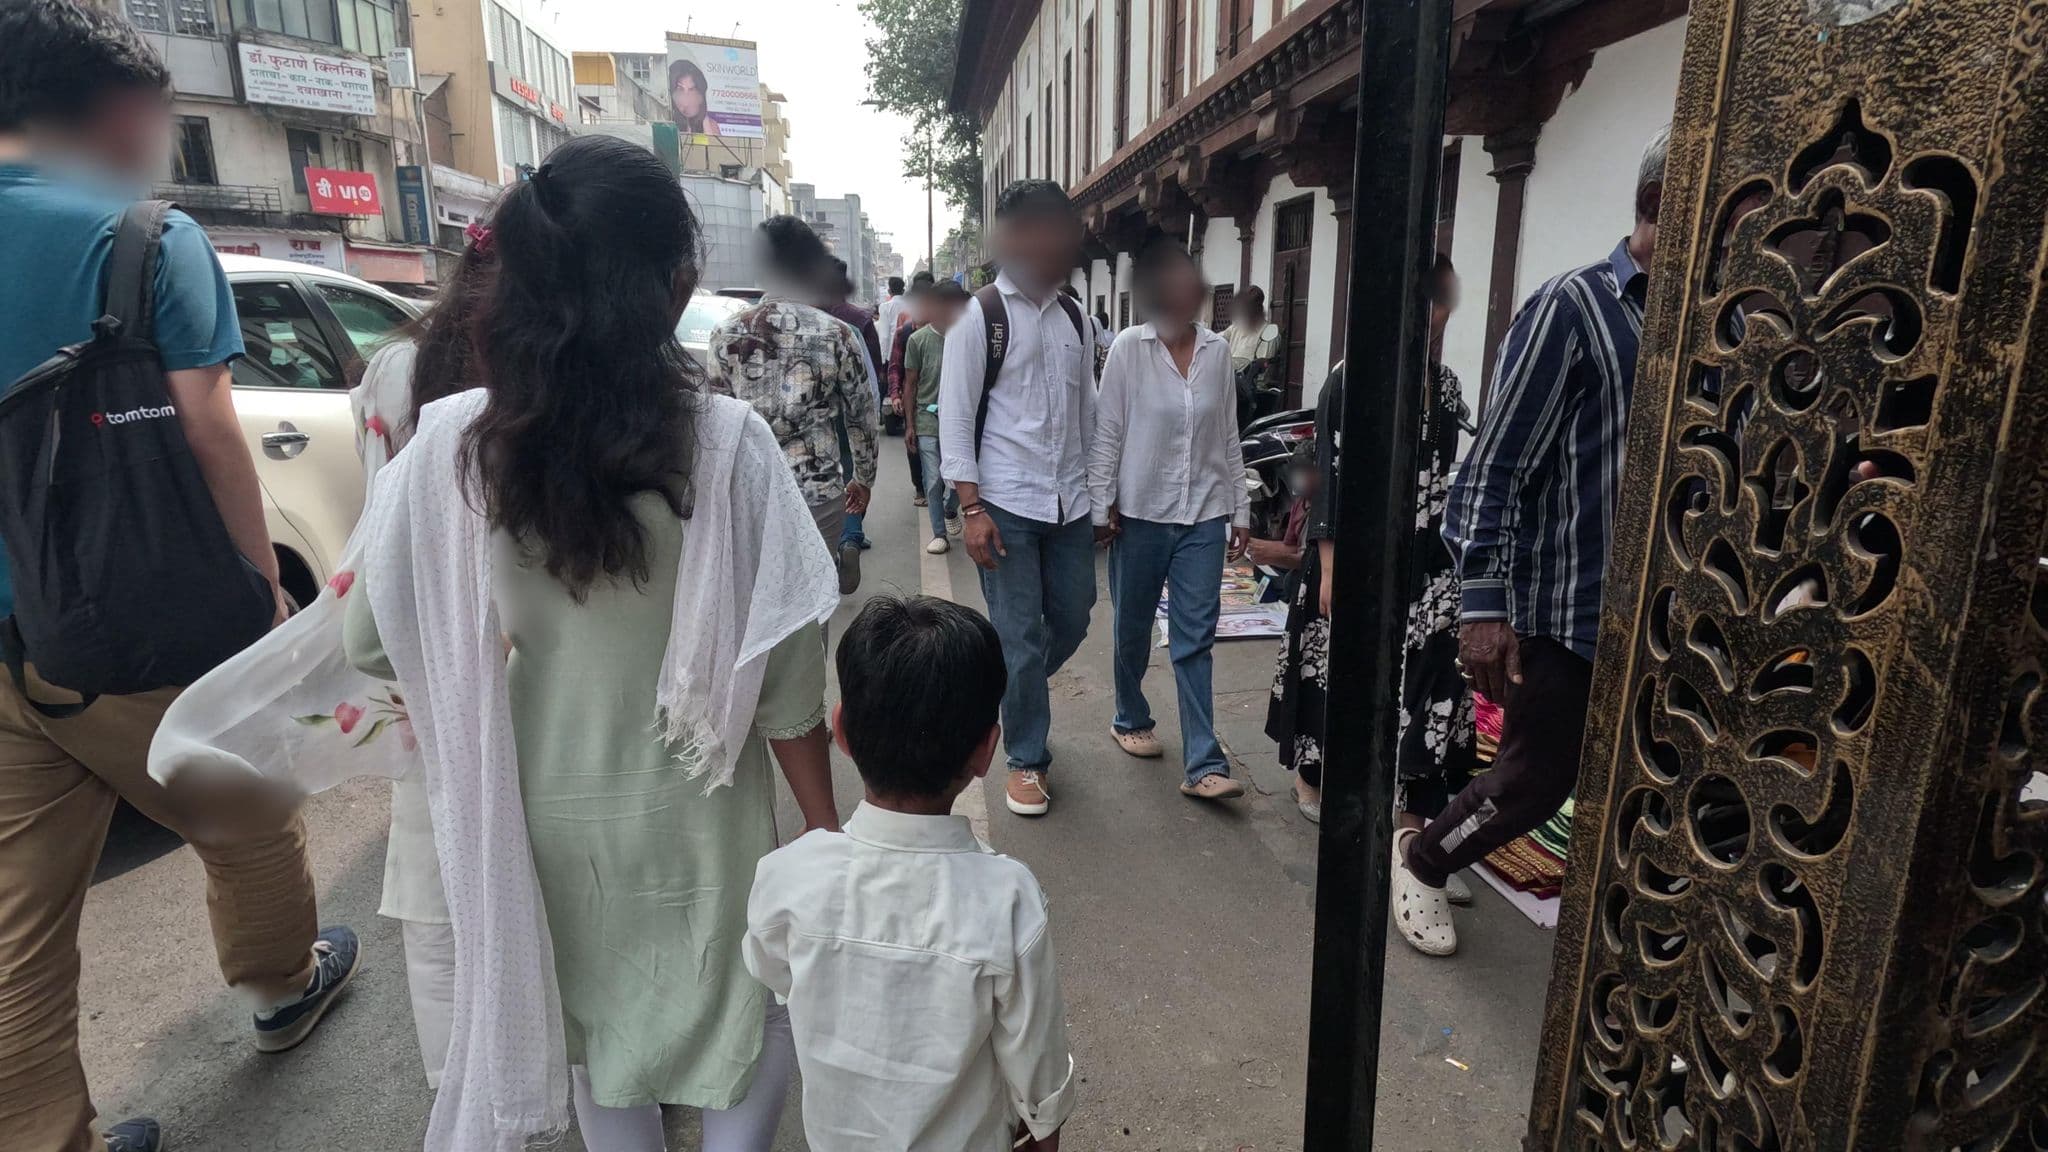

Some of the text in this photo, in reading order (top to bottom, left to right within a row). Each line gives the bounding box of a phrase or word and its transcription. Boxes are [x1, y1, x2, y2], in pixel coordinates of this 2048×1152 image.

[313, 57, 366, 79] क्लिनिक
[992, 323, 1003, 358] safari
[106, 405, 175, 424] tomtom
